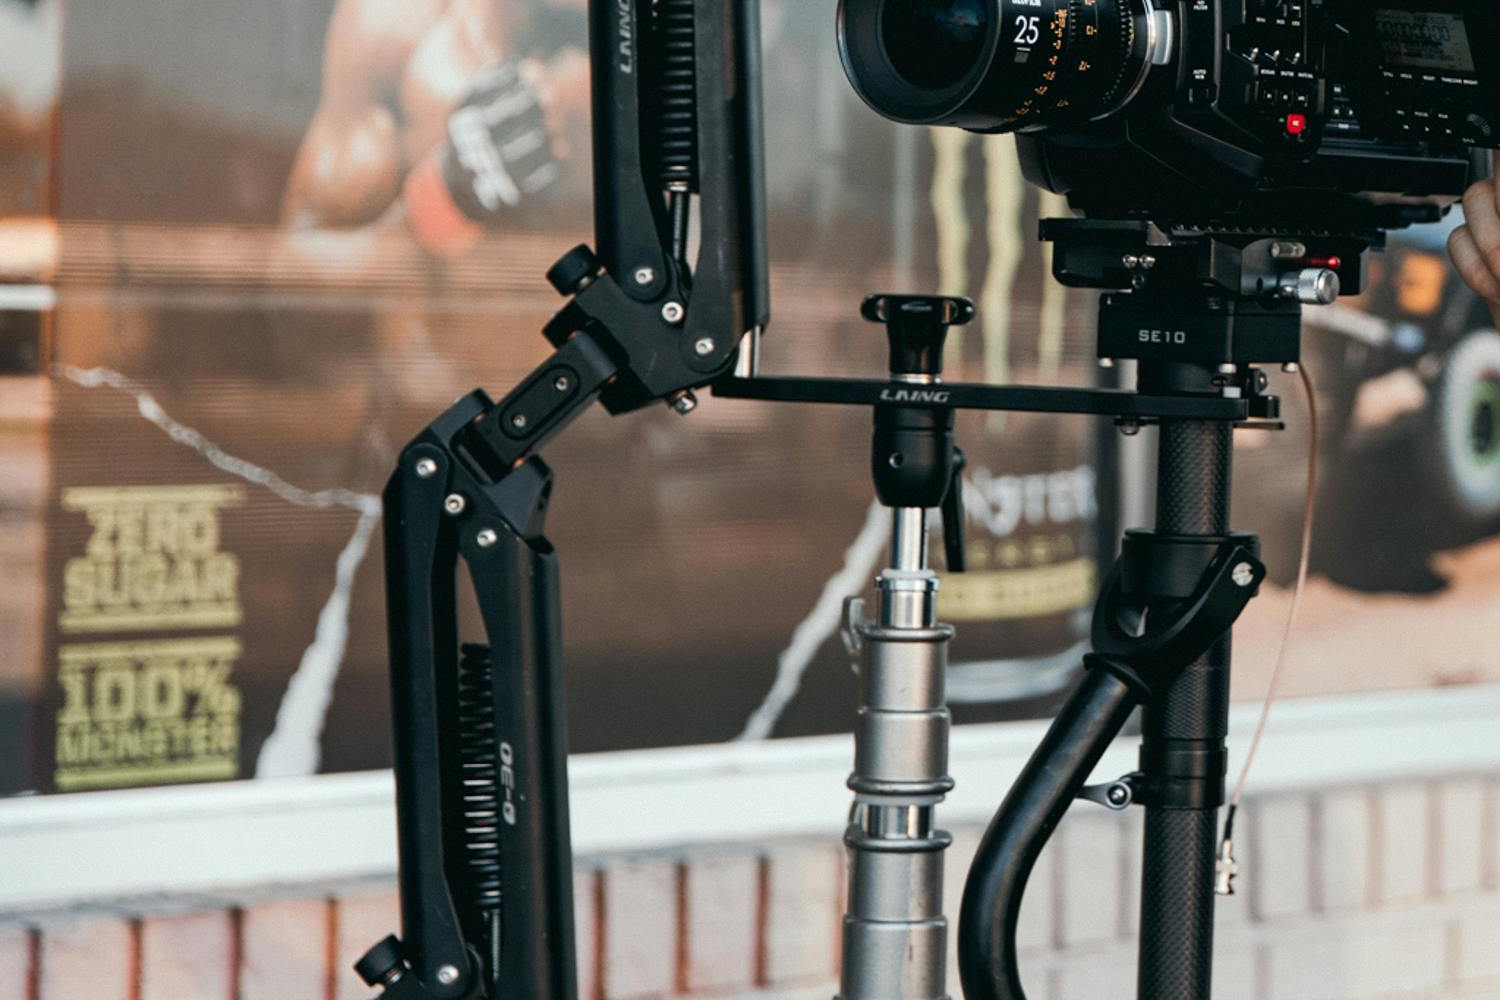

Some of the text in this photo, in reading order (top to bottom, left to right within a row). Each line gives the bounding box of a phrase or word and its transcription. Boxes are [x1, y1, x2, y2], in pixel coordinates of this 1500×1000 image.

[1013, 14, 1040, 45] 25
[1138, 329, 1186, 344] SE10
[880, 388, 951, 403] LAING
[87, 506, 219, 555] ZERO
[64, 552, 239, 608] SUGAR
[59, 662, 239, 719] 100%
